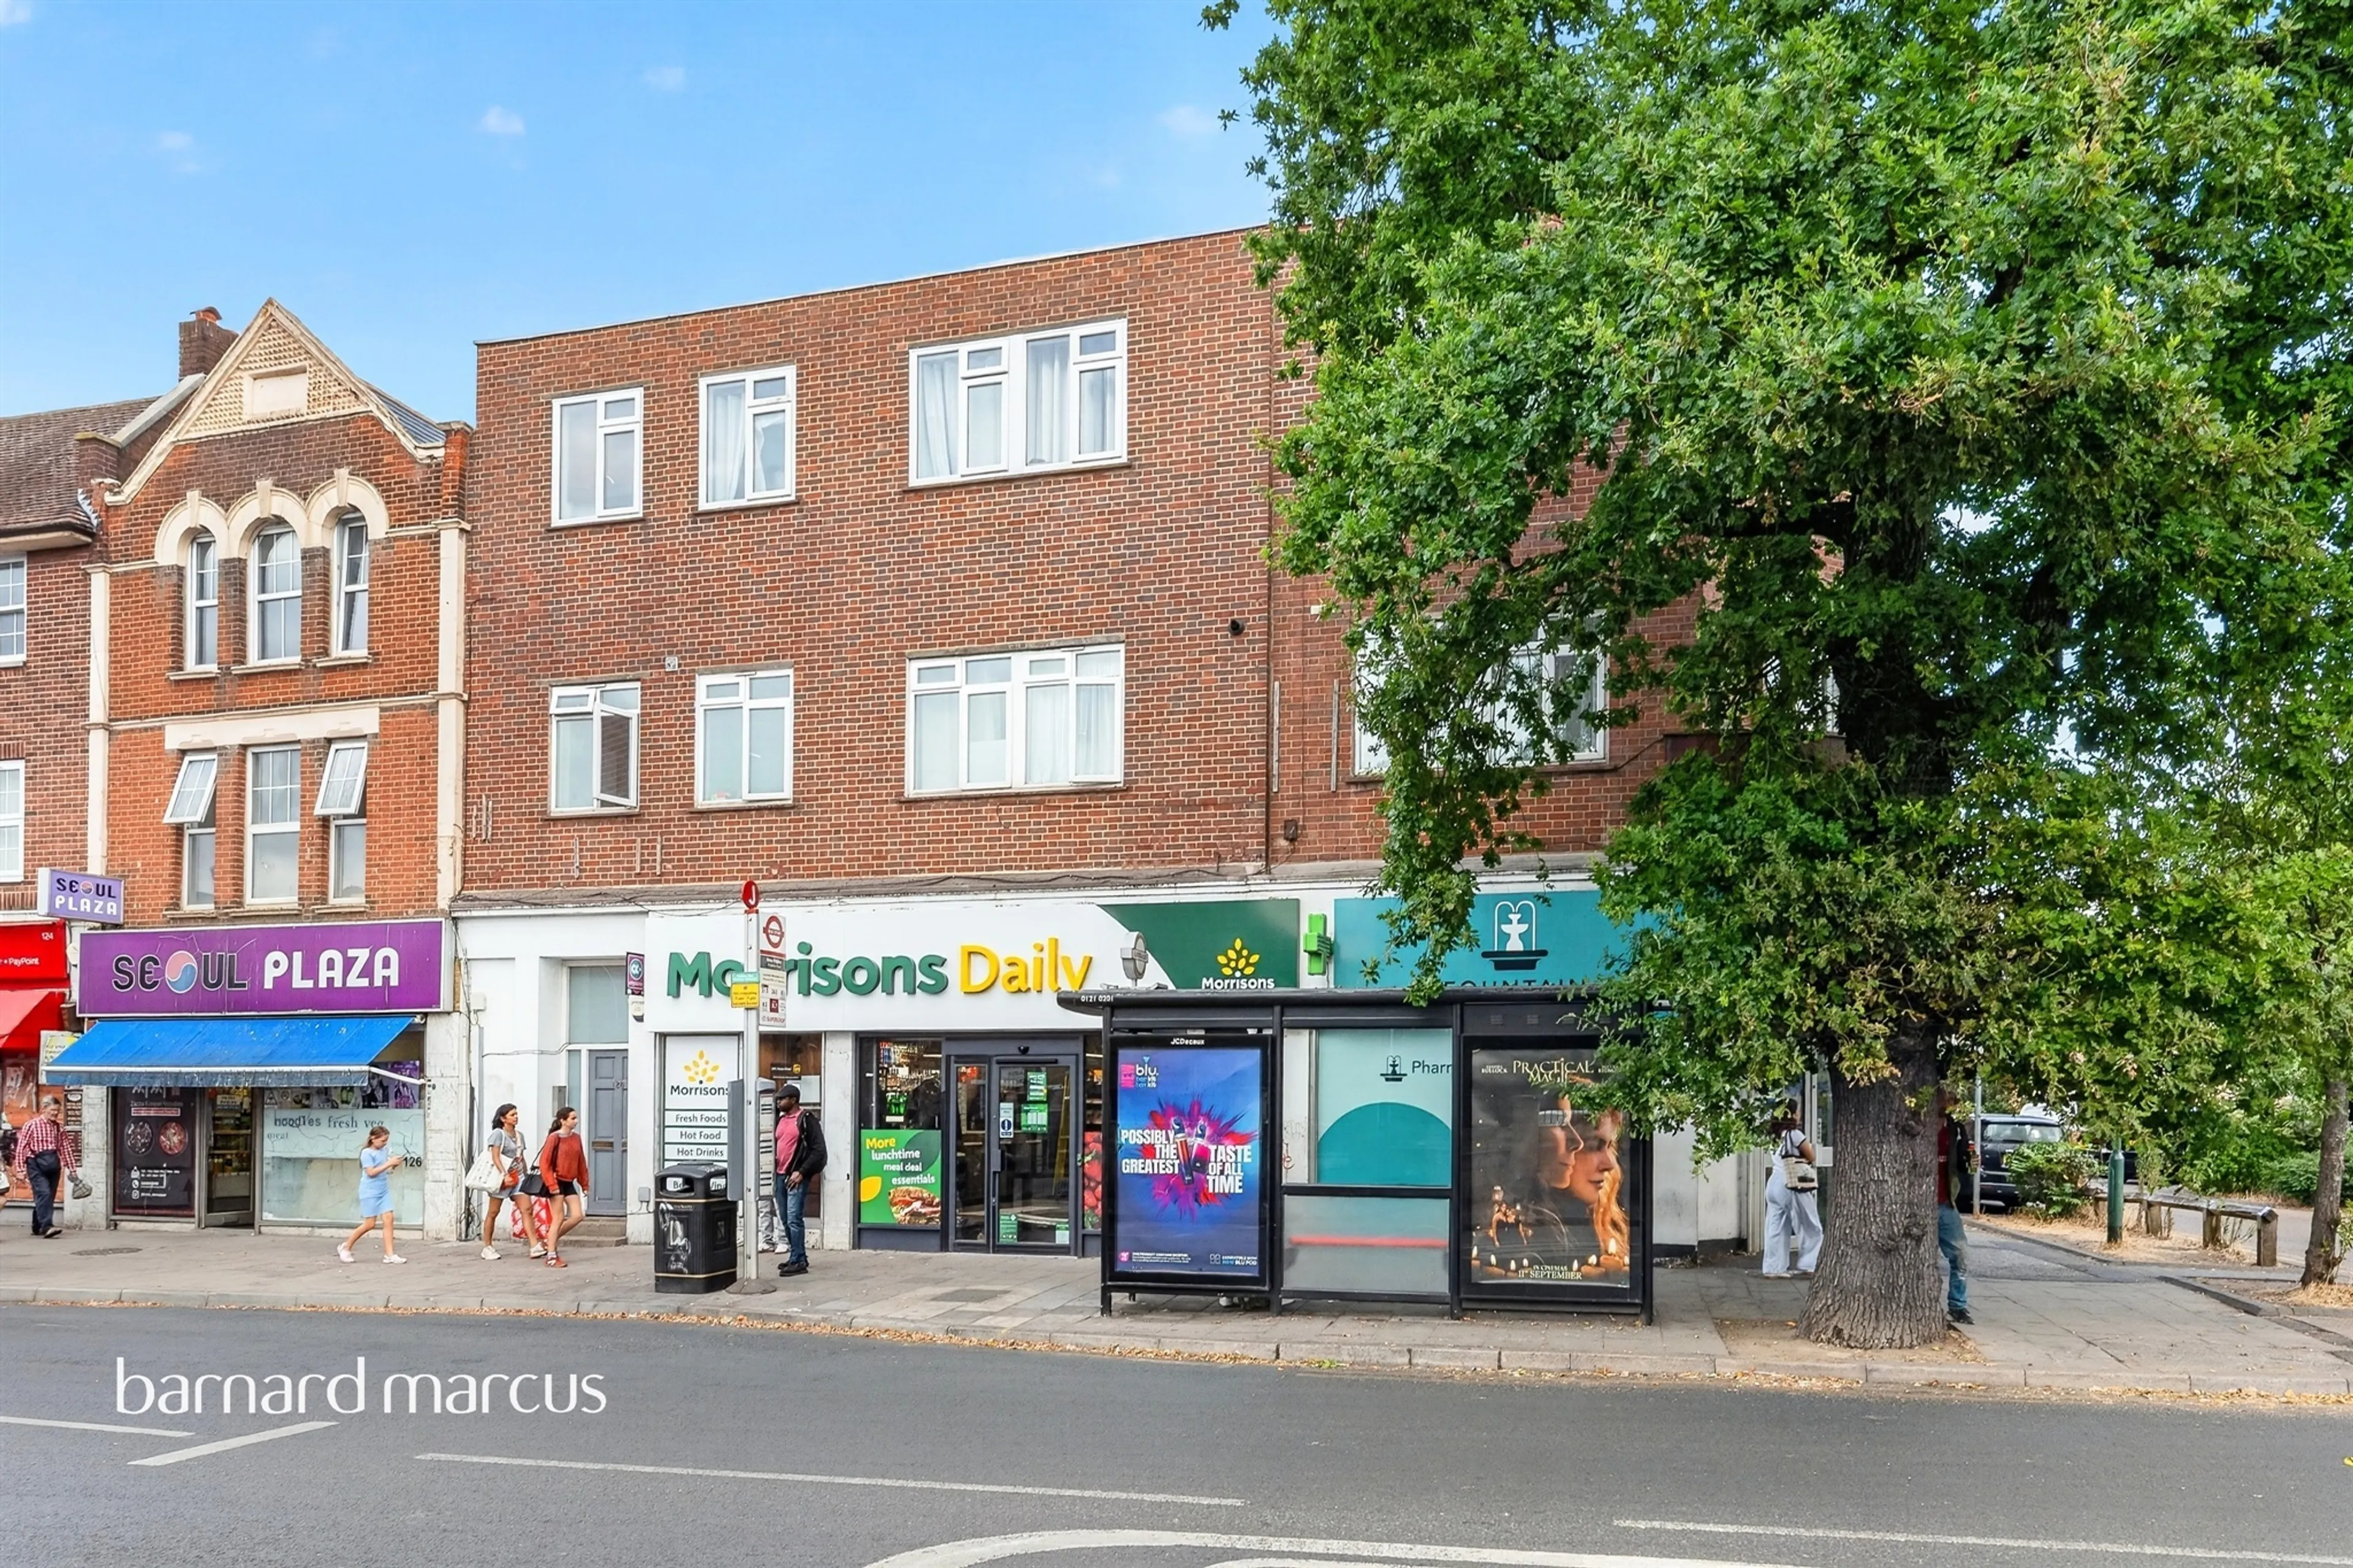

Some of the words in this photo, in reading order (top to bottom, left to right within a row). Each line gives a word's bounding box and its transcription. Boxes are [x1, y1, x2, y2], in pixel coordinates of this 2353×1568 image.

[56, 878, 116, 898] SEOUL
[748, 885, 756, 906] J
[55, 895, 118, 915] PLAZA
[41, 931, 54, 941] 124
[8, 957, 40, 967] PayPoint
[112, 950, 248, 993] SEOUL
[263, 947, 399, 989] PLAZA
[1201, 977, 1275, 990] Morrisons
[1513, 1058, 1594, 1074] PRACTICAL
[328, 1115, 358, 1129] fresh
[675, 1113, 698, 1123] Fresh
[700, 1114, 726, 1123] Foods
[680, 1131, 697, 1140] Hot
[699, 1131, 722, 1140] Food
[1121, 1129, 1175, 1145] POSSIBLY
[865, 1137, 896, 1150] More
[676, 1148, 694, 1157] Hot
[696, 1148, 724, 1157] Drinks
[871, 1148, 920, 1161] lunchtime
[1154, 1144, 1177, 1159] THE
[1208, 1145, 1252, 1162] TASTE
[404, 1157, 422, 1167] 126
[883, 1162, 903, 1172] meal
[904, 1162, 922, 1172] deal
[1121, 1159, 1180, 1174] GREATEST
[1208, 1162, 1224, 1175] OF
[1224, 1162, 1244, 1175] ALL
[892, 1173, 936, 1186] essentials
[1206, 1176, 1243, 1194] TIME
[1529, 1270, 1583, 1280] SEPTEMBER
